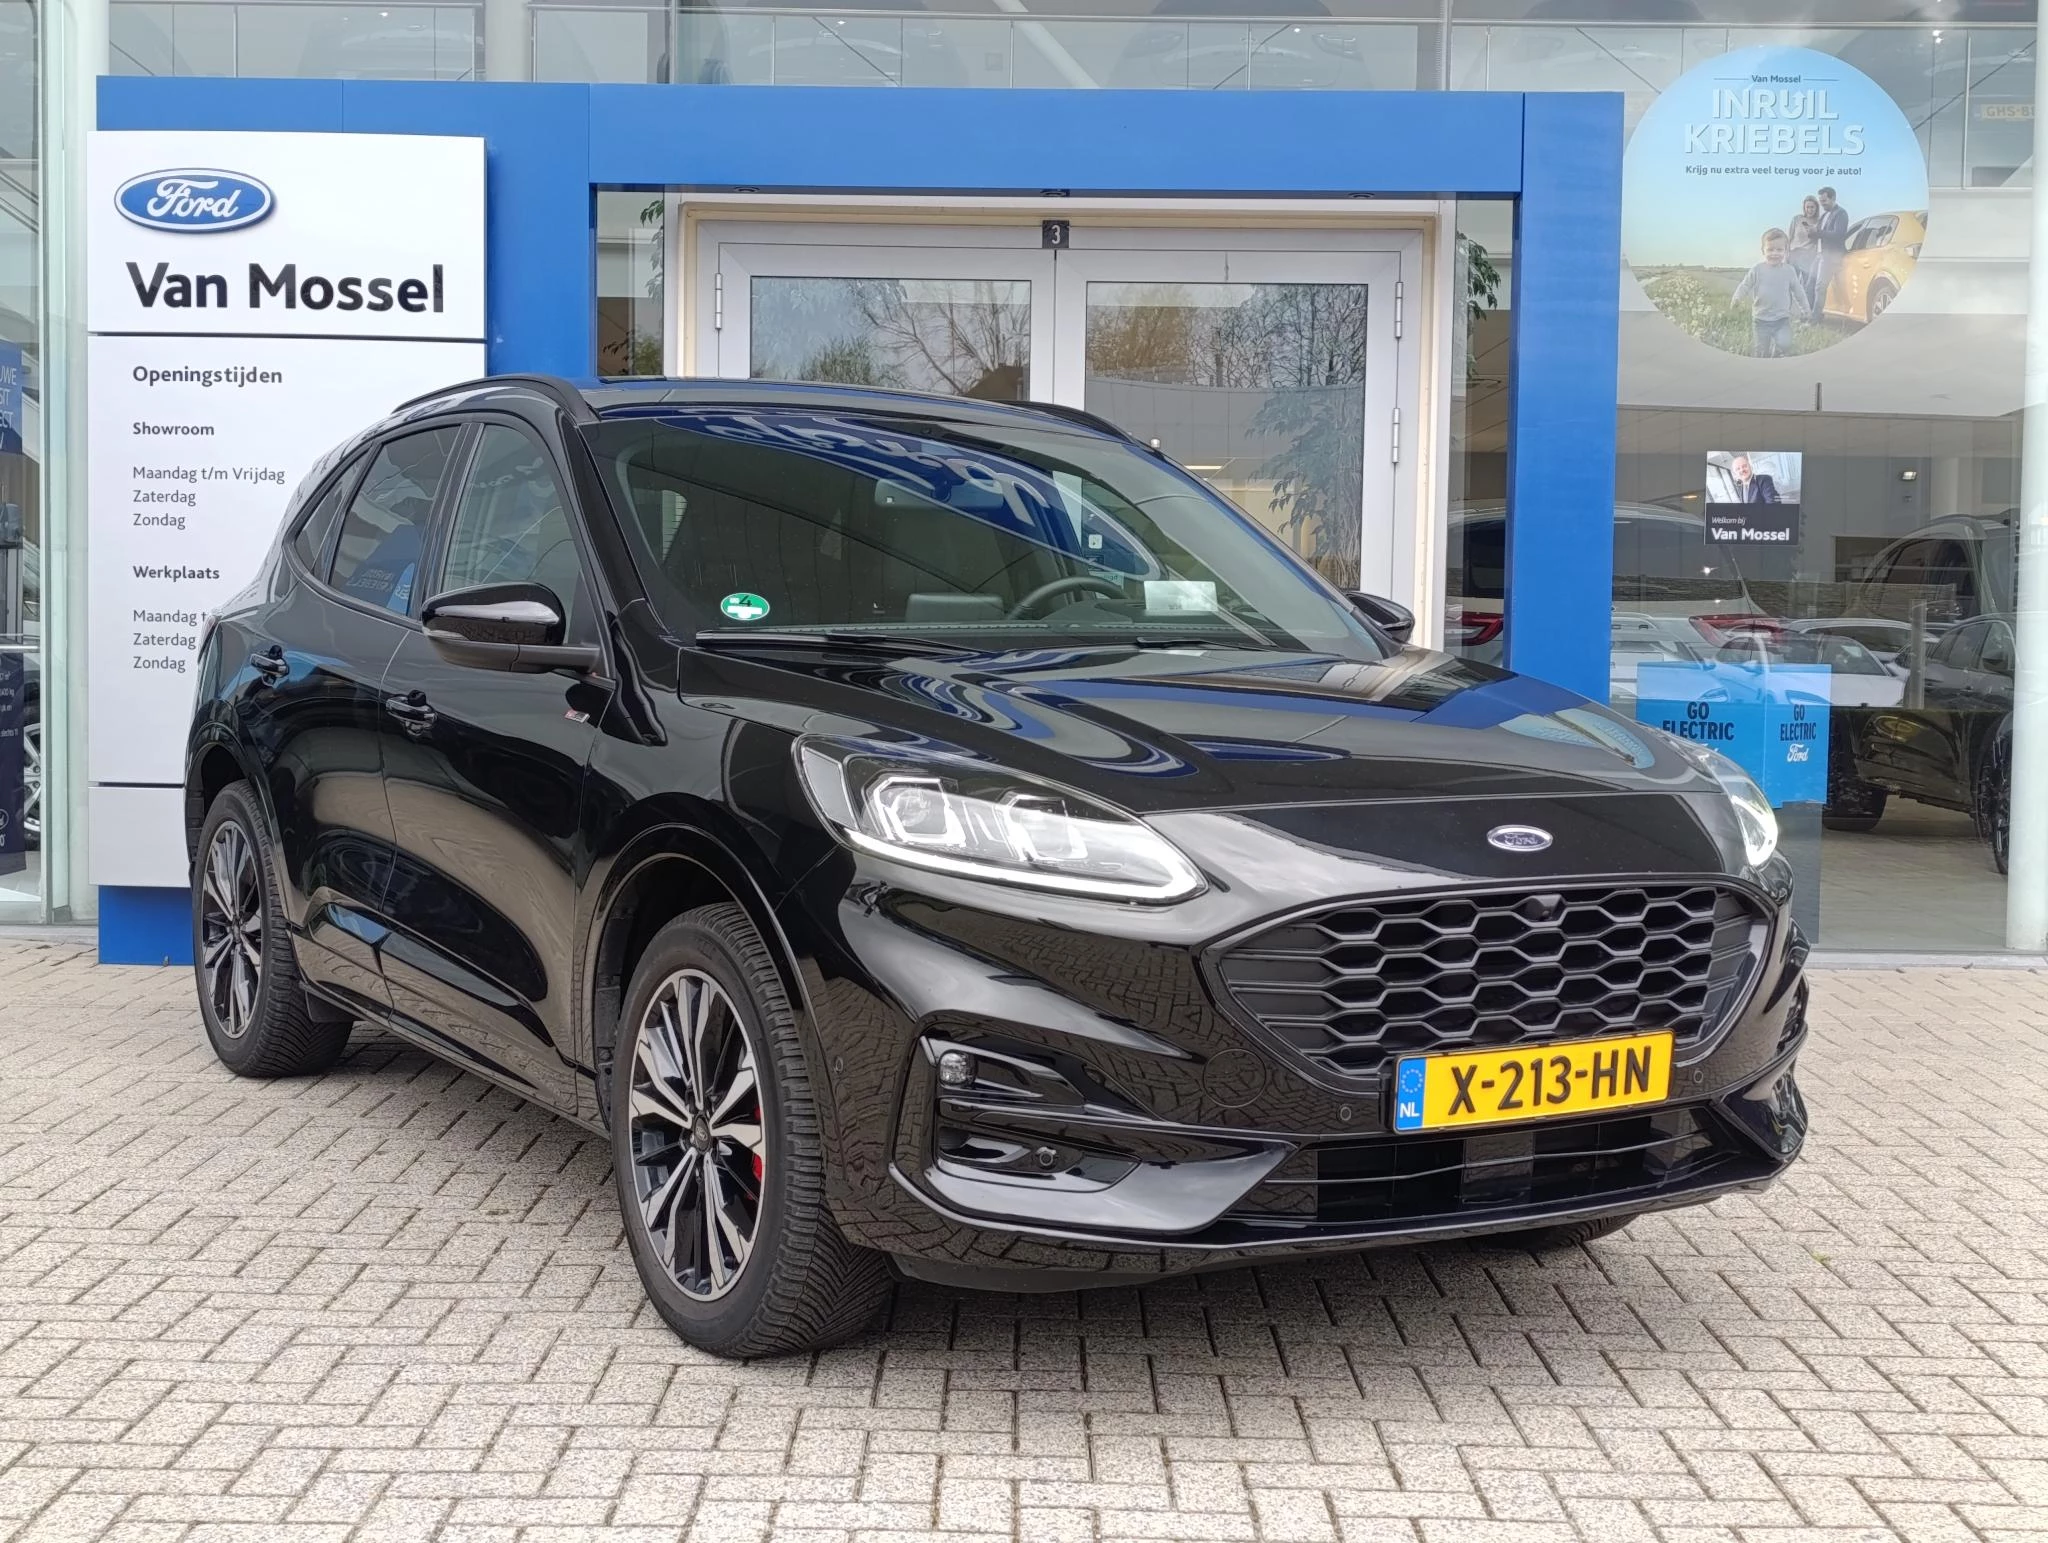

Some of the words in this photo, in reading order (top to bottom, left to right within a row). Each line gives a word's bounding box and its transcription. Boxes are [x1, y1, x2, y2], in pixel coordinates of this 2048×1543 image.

[1752, 75, 1768, 83] Van
[1770, 75, 1801, 83] Mossel
[1712, 88, 1839, 120] INRUIL
[1684, 123, 1866, 156] KRIEBELS
[1685, 165, 1708, 176] Krijg
[1724, 166, 1750, 175] extra
[1751, 166, 1772, 175] veel
[1774, 166, 1800, 176] terug
[1802, 167, 1824, 175] voor
[1825, 166, 1835, 176] je
[1837, 167, 1862, 176] auto!
[147, 178, 242, 217] Ford
[1051, 224, 1061, 245] 3
[126, 261, 228, 308] Van
[248, 263, 444, 312] Mossel
[132, 365, 283, 388] Openingstijden
[132, 421, 215, 436] Showroom
[132, 466, 198, 483] Maandag
[201, 467, 229, 480] t/m
[232, 467, 286, 484] Vrijdag
[132, 490, 197, 507] Zaterdag
[132, 513, 186, 530] Zondag
[1711, 527, 1738, 541] Van
[1741, 527, 1790, 541] Mossel
[132, 566, 220, 582] Werkplaats
[739, 595, 752, 607] 4
[132, 609, 198, 627] Maandag
[132, 633, 197, 650] Zaterdag
[132, 656, 186, 673] Zondag
[1687, 701, 1710, 720] GO
[1793, 703, 1806, 721] GO
[1780, 722, 1817, 742] ELECTRIC
[1787, 743, 1809, 762] Ford
[1447, 1045, 1652, 1116] X-213-HN
[1399, 1101, 1420, 1118] NL
